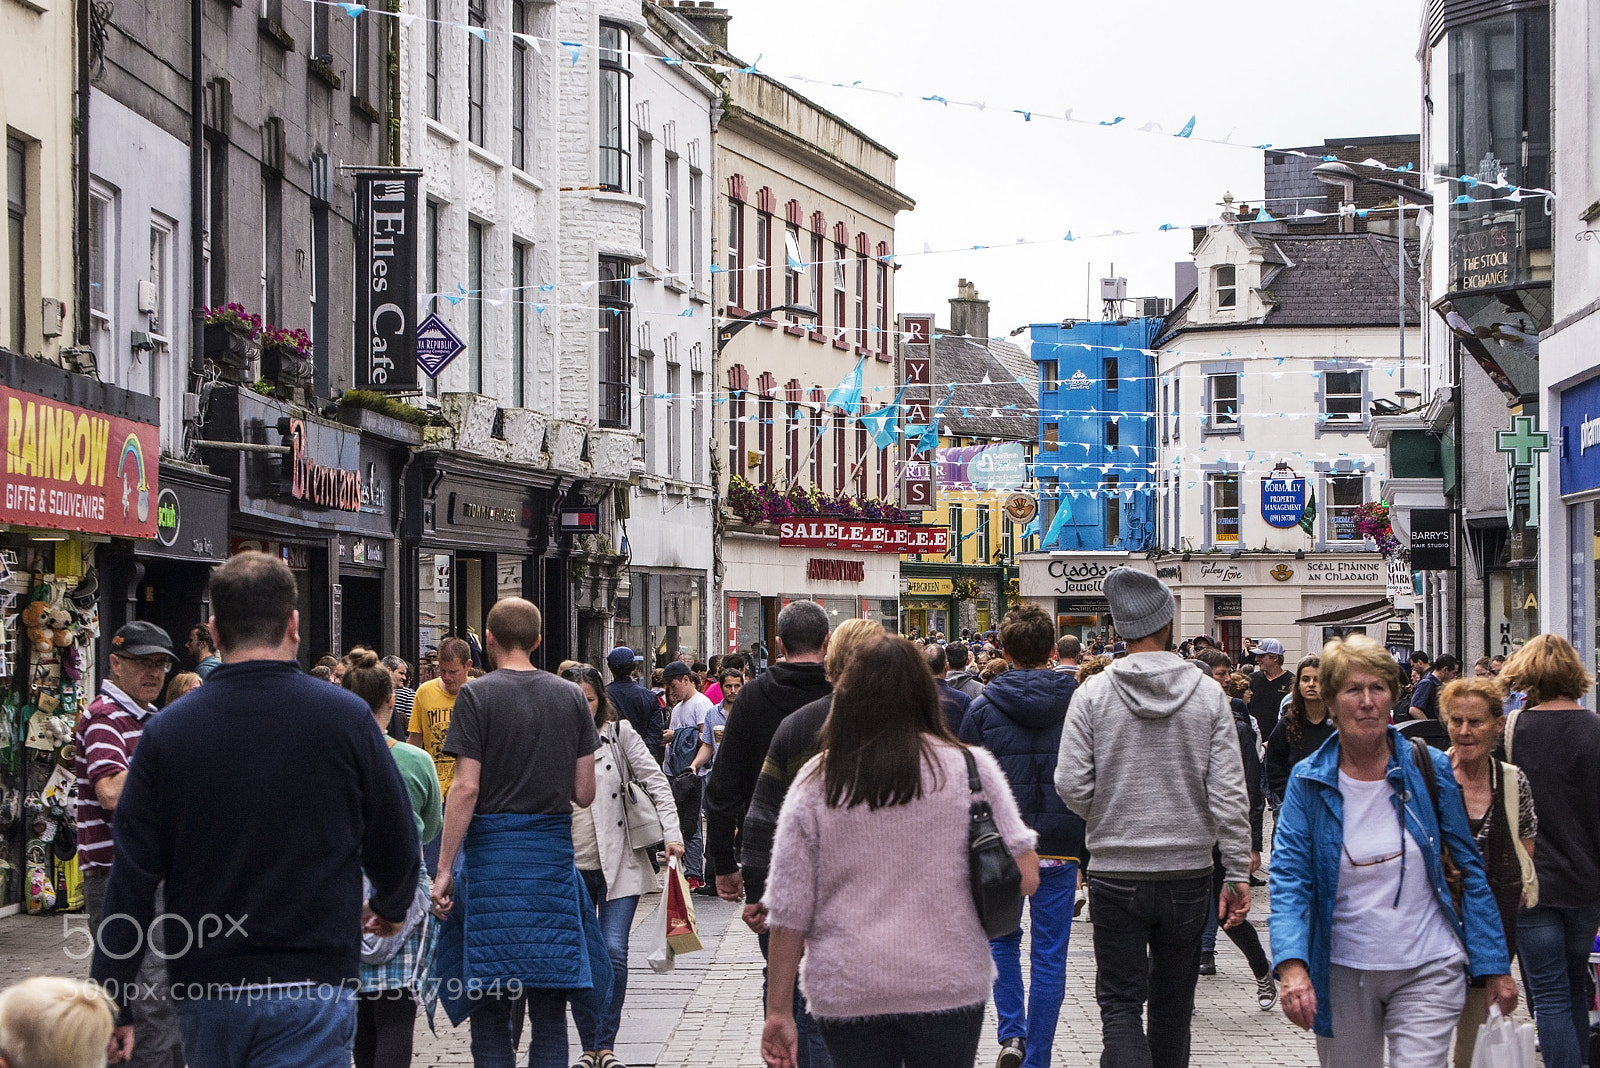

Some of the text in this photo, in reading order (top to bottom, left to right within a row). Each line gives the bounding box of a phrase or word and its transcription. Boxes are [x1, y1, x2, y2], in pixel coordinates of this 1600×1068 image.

[373, 208, 405, 293] Elles
[1463, 252, 1508, 271] THE STOCK
[1463, 270, 1508, 289] EXCHANGE
[373, 302, 405, 384] Cafe
[427, 340, 453, 350] REPUBLIC
[7, 396, 110, 487] RAINBOW
[290, 418, 361, 513] Brennans
[1264, 483, 1301, 493] GORMALLY
[6, 483, 105, 520] GIFTS & SOUVENIRS
[1270, 495, 1296, 503] PROPERTY
[1218, 532, 1239, 541] LETTING
[1411, 531, 1449, 540] BARRY'S
[1048, 561, 1125, 581] Cladda
[1387, 574, 1410, 585] MARK
[1054, 581, 1102, 594] Jewell
[1500, 623, 1511, 656] HAI
